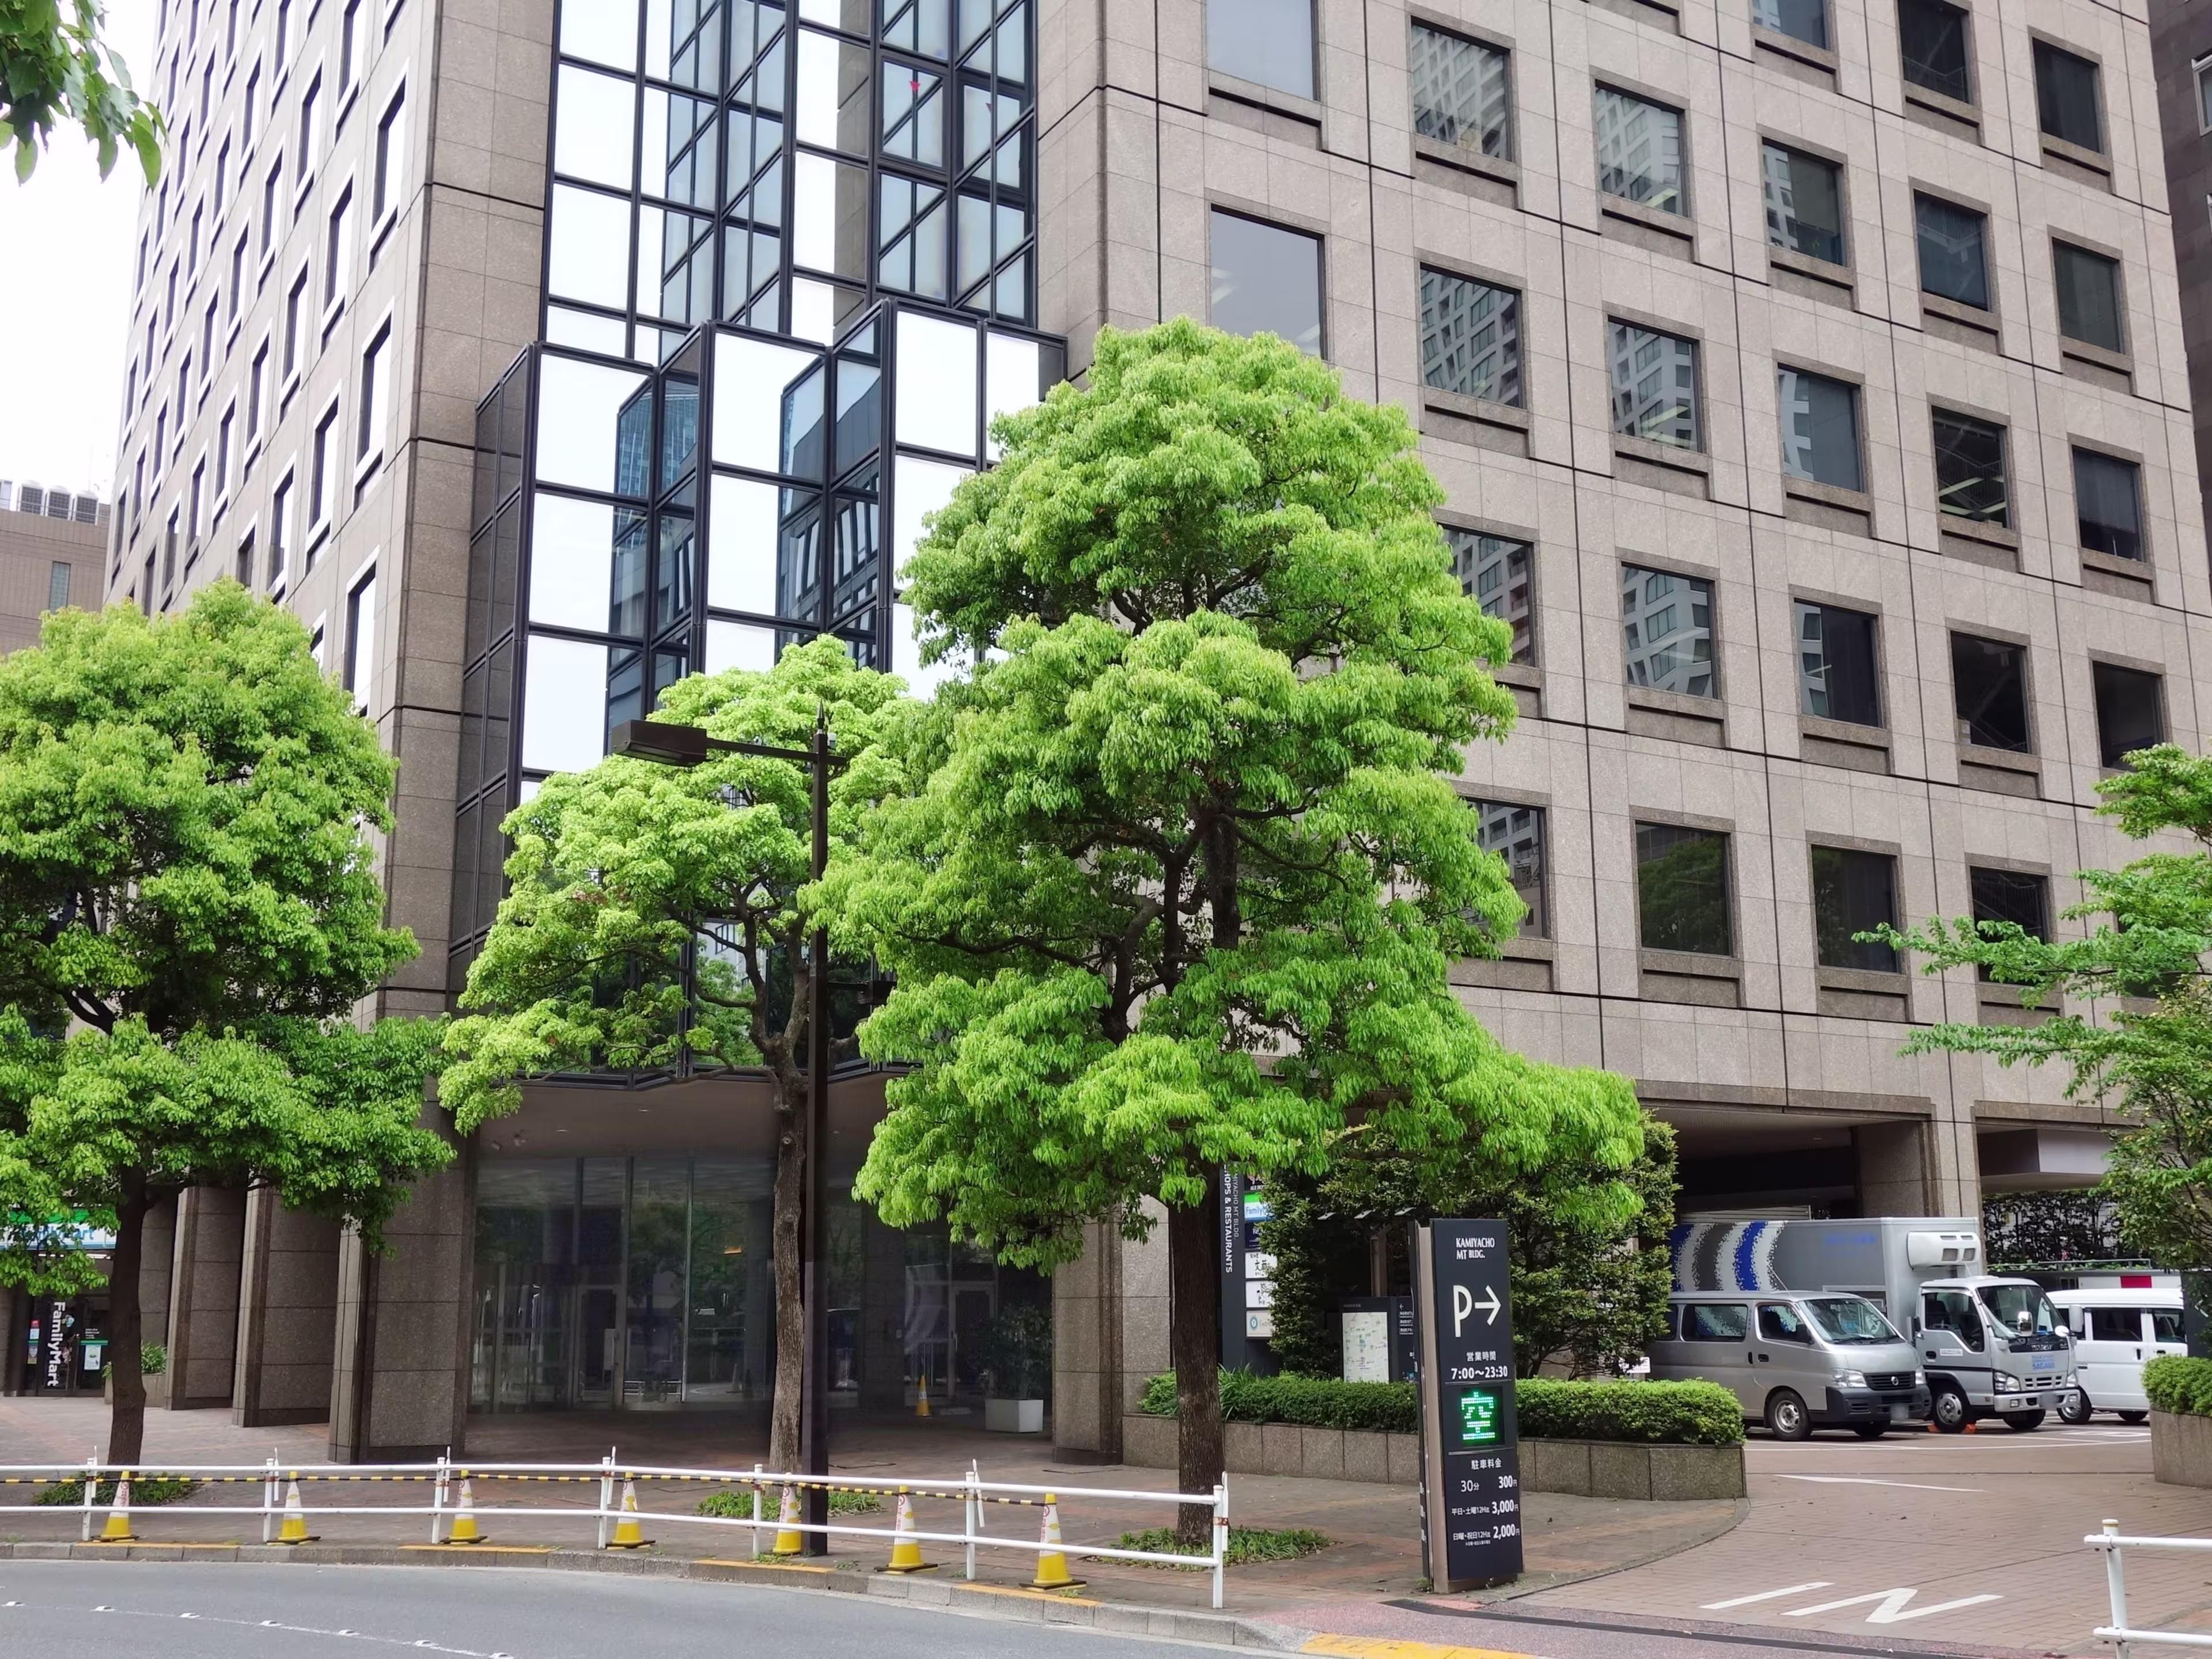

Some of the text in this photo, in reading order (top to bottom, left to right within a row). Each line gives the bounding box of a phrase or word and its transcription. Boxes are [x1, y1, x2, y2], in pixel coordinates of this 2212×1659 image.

[1233, 1206, 1239, 1216] MT
[1225, 1207, 1233, 1273] RESTAURANTS
[1456, 1237, 1495, 1249] KAMIYACHO
[1456, 1249, 1486, 1260] MT BLDG.
[1453, 1285, 1472, 1338] P
[46, 1301, 66, 1387] FamilyMart
[1466, 1351, 1497, 1362] 営業時間
[1460, 1391, 1496, 1440] 空
[1471, 1458, 1502, 1470] 駐車料金
[1460, 1475, 1517, 1493] 30分 300円
[1491, 1499, 1518, 1516] 3,000円
[1493, 1524, 1520, 1540] 2,000円
[1699, 1582, 2005, 1624] IN
